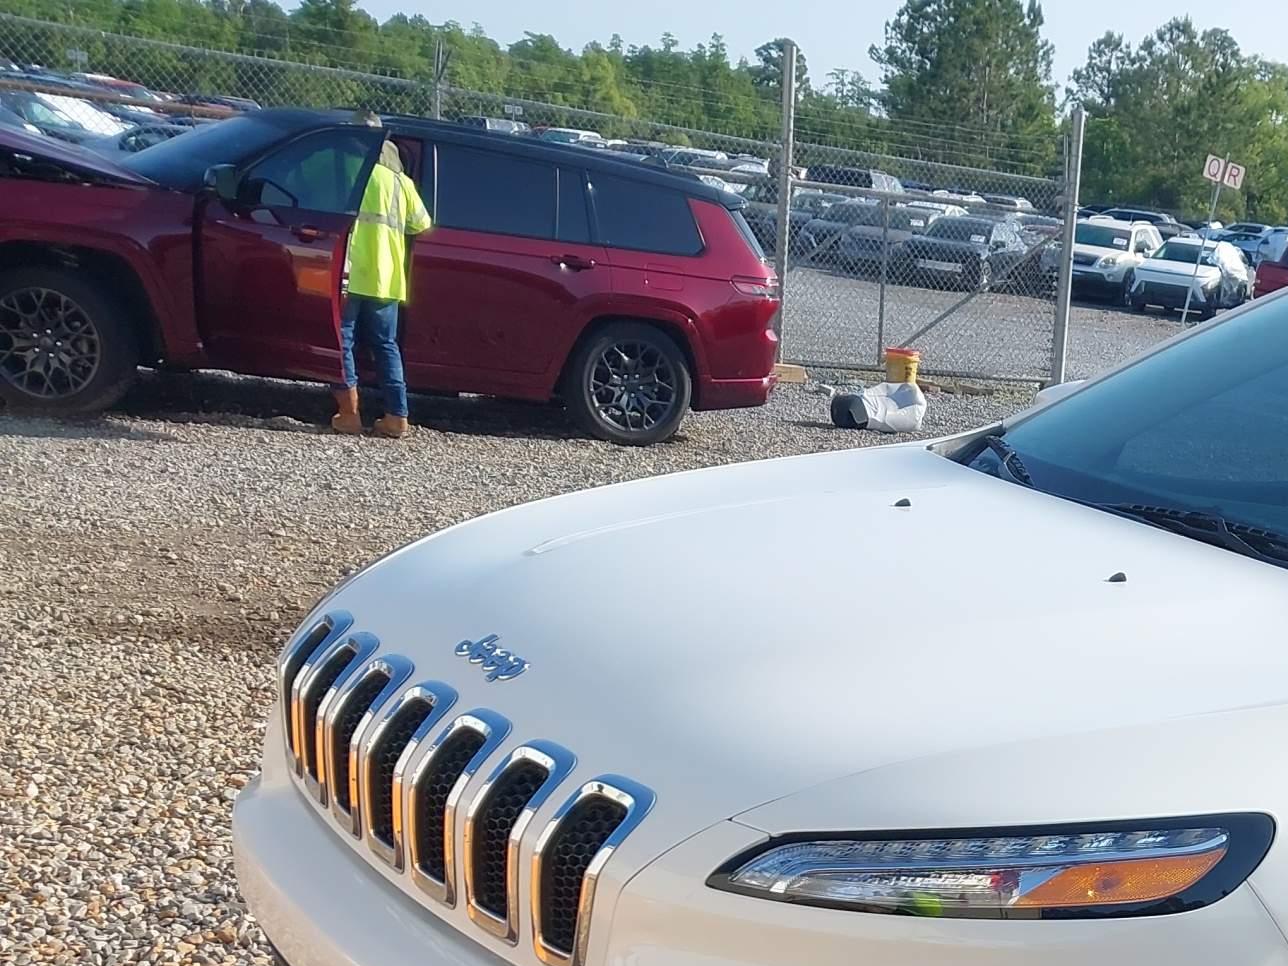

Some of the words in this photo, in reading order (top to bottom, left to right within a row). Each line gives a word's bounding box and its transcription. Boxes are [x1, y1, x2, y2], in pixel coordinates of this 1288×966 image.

[1208, 158, 1221, 180] Q
[1227, 165, 1240, 187] R
[455, 633, 530, 683] Jeep
